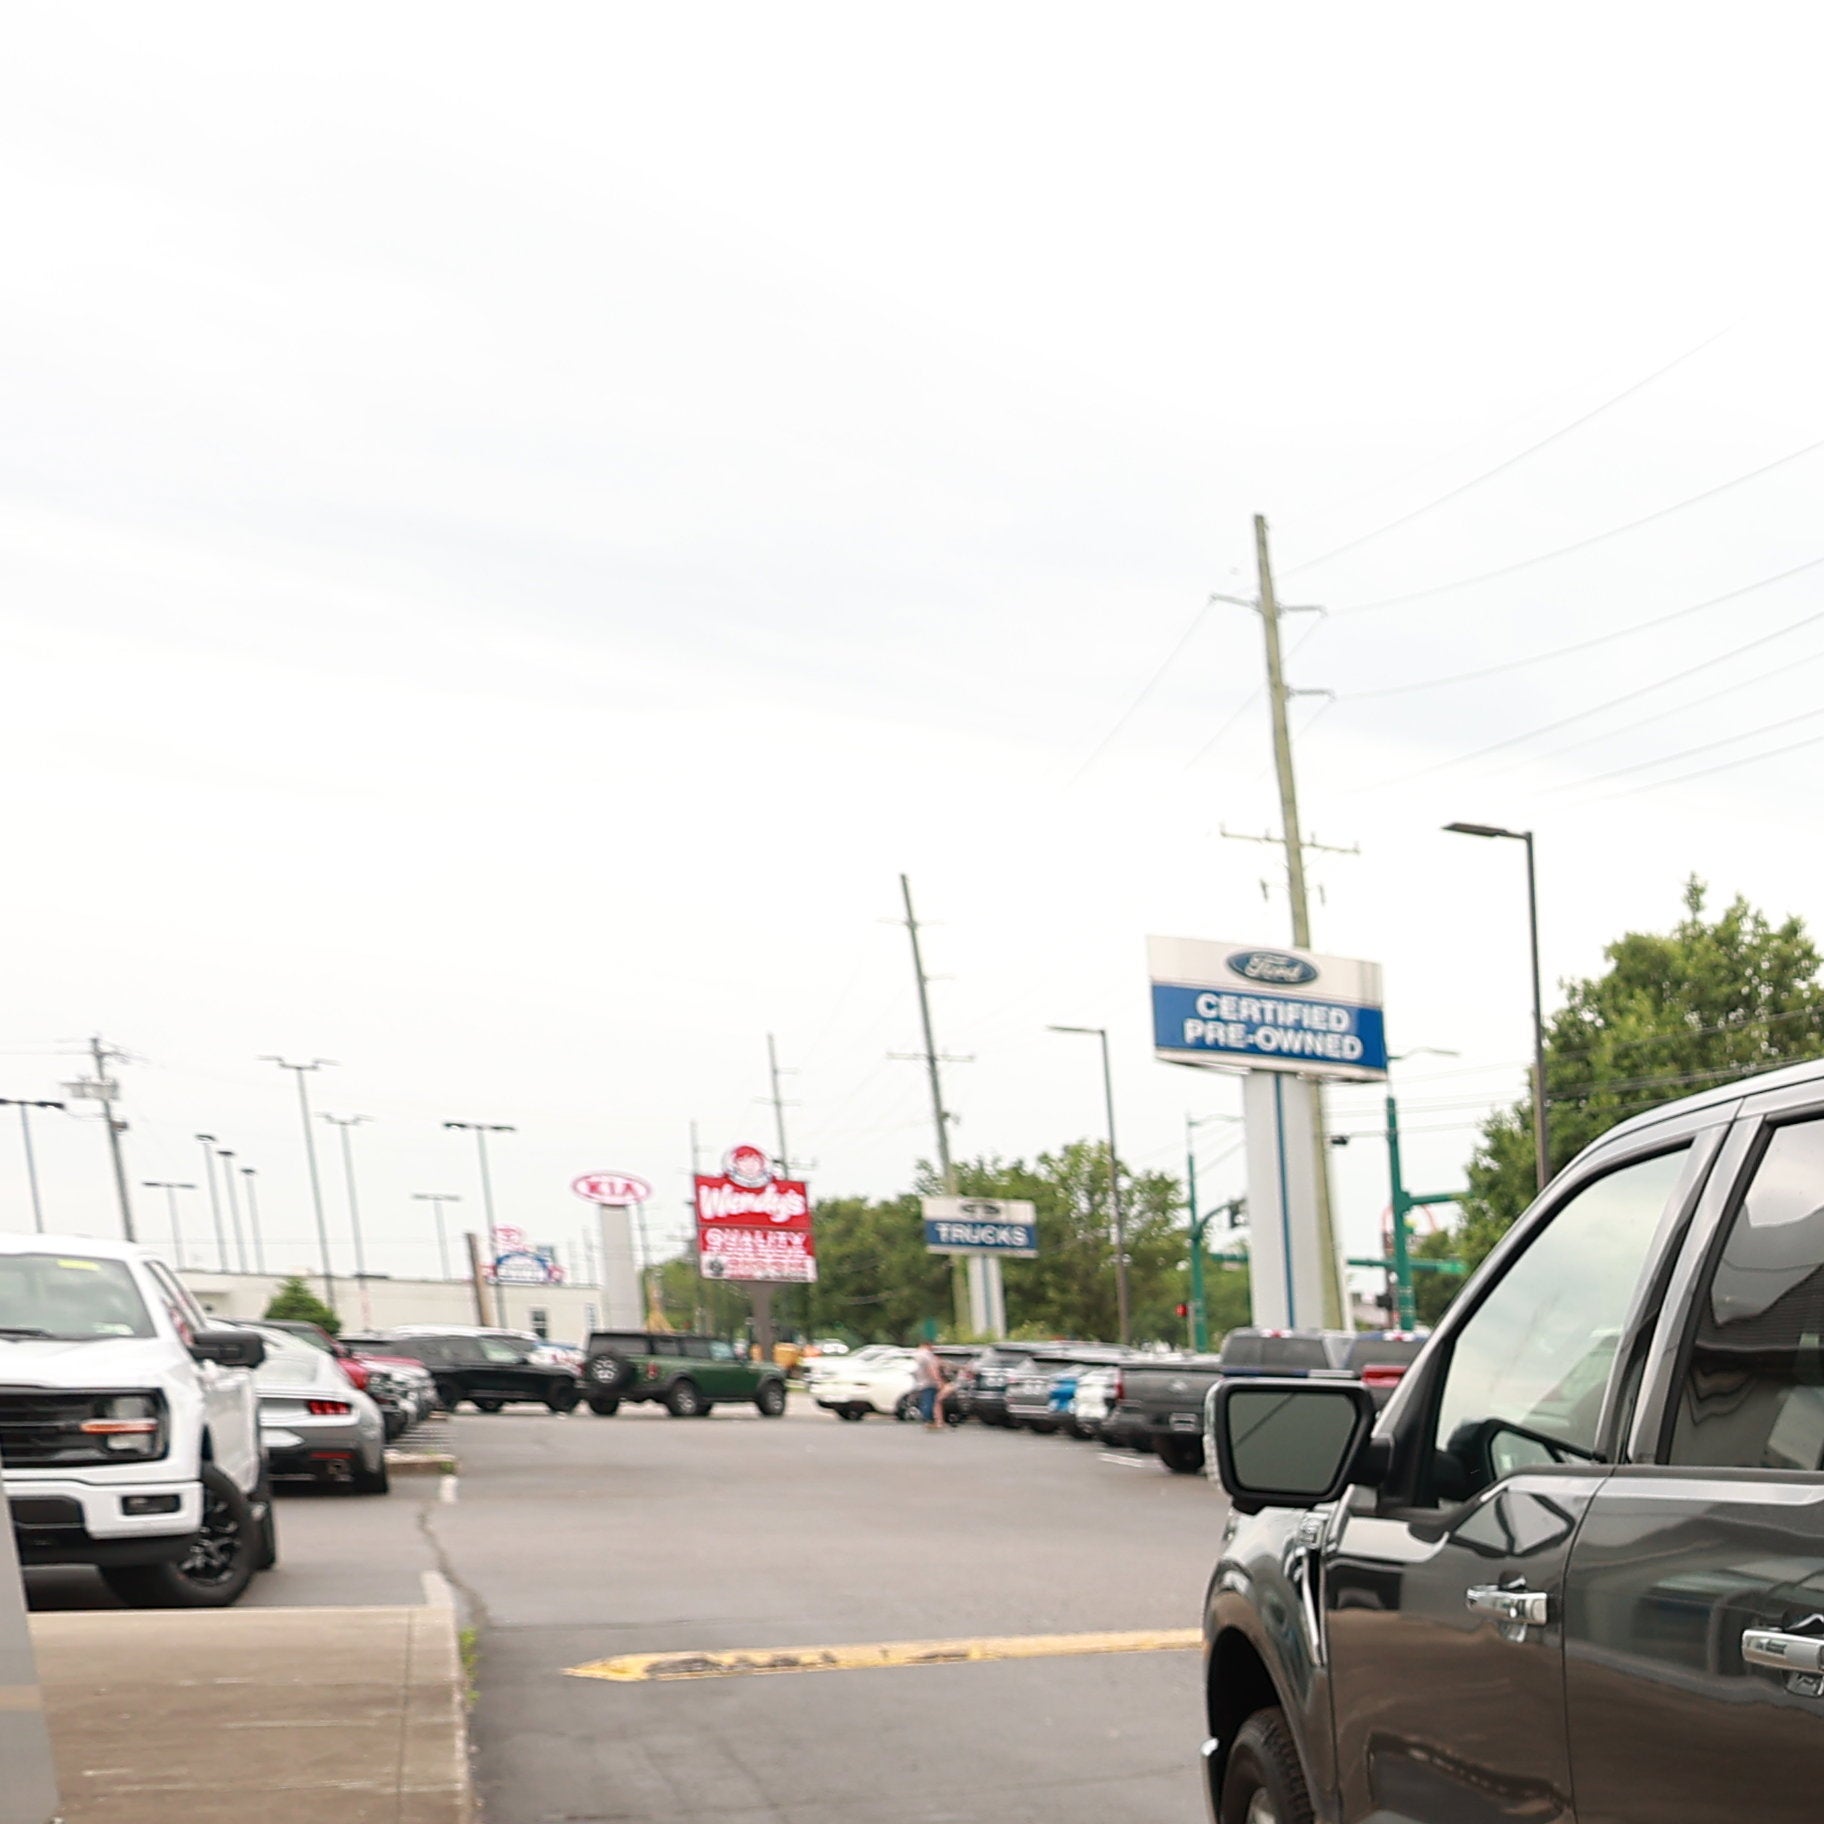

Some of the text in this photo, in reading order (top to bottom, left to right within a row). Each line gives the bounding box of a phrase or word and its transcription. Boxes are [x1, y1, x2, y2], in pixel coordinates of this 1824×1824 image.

[1244, 952, 1300, 982] Ford
[1196, 993, 1349, 1033] CERTIFIED
[1184, 1018, 1364, 1060] PRE-OWNED
[585, 1180, 638, 1197] KIA
[699, 1183, 807, 1223] Wendy's
[935, 1222, 1030, 1247] TRUCKS
